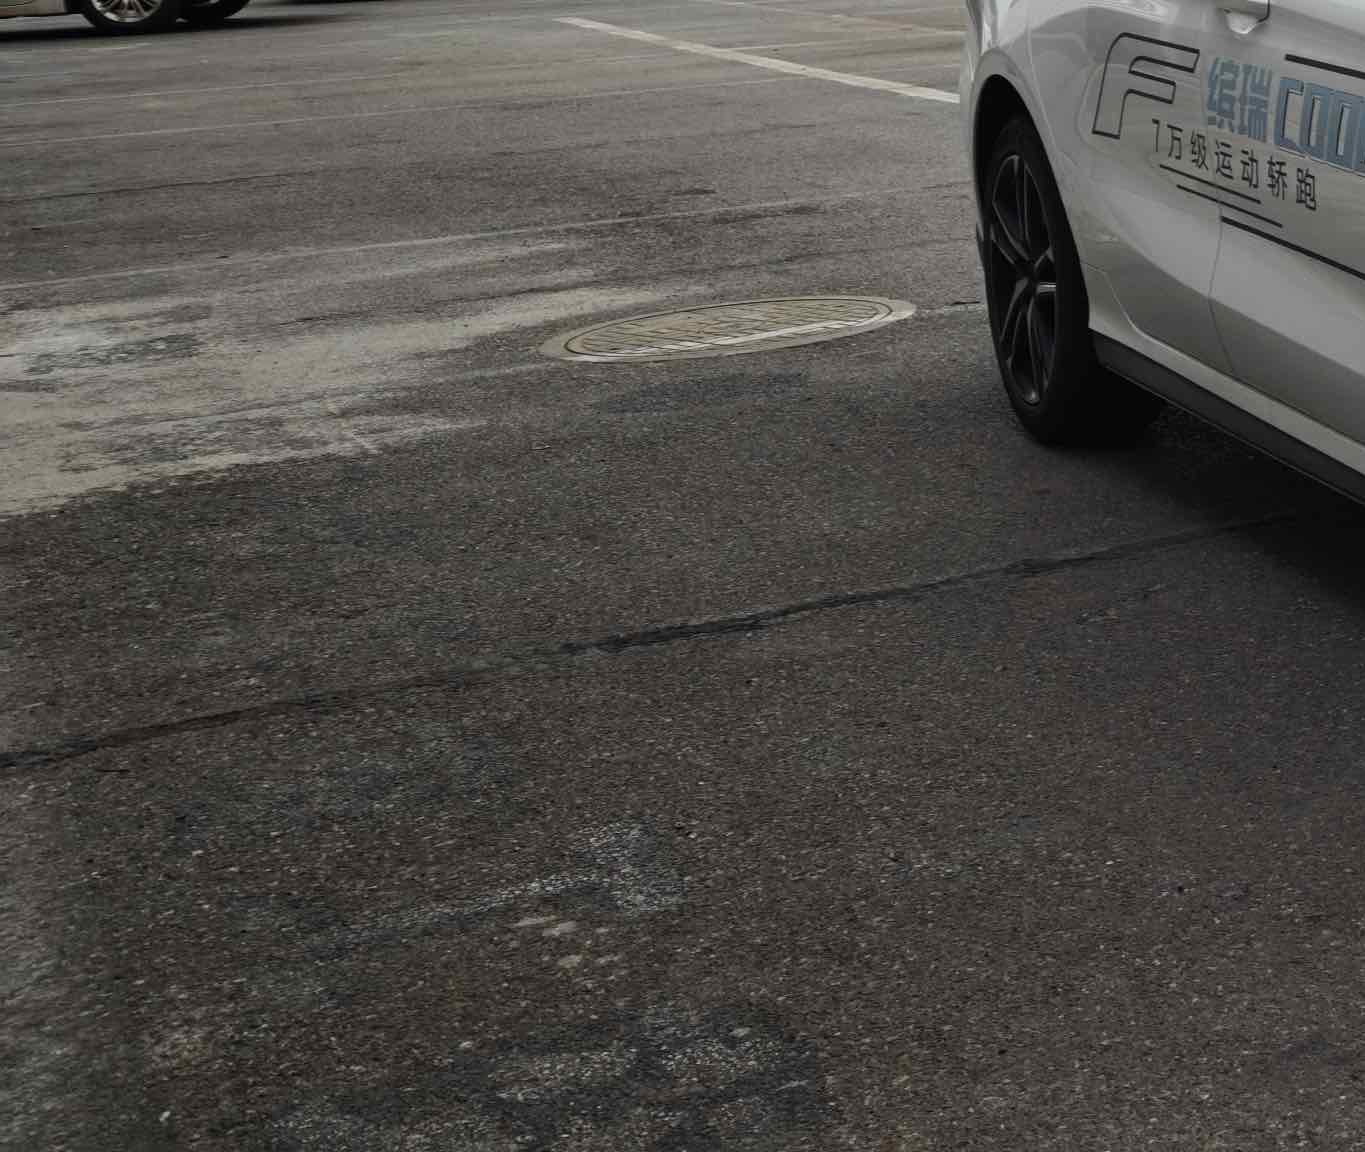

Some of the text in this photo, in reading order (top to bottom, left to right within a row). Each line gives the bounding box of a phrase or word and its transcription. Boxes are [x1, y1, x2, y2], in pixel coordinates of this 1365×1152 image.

[1151, 118, 1318, 211] 7万级运动轿跑
